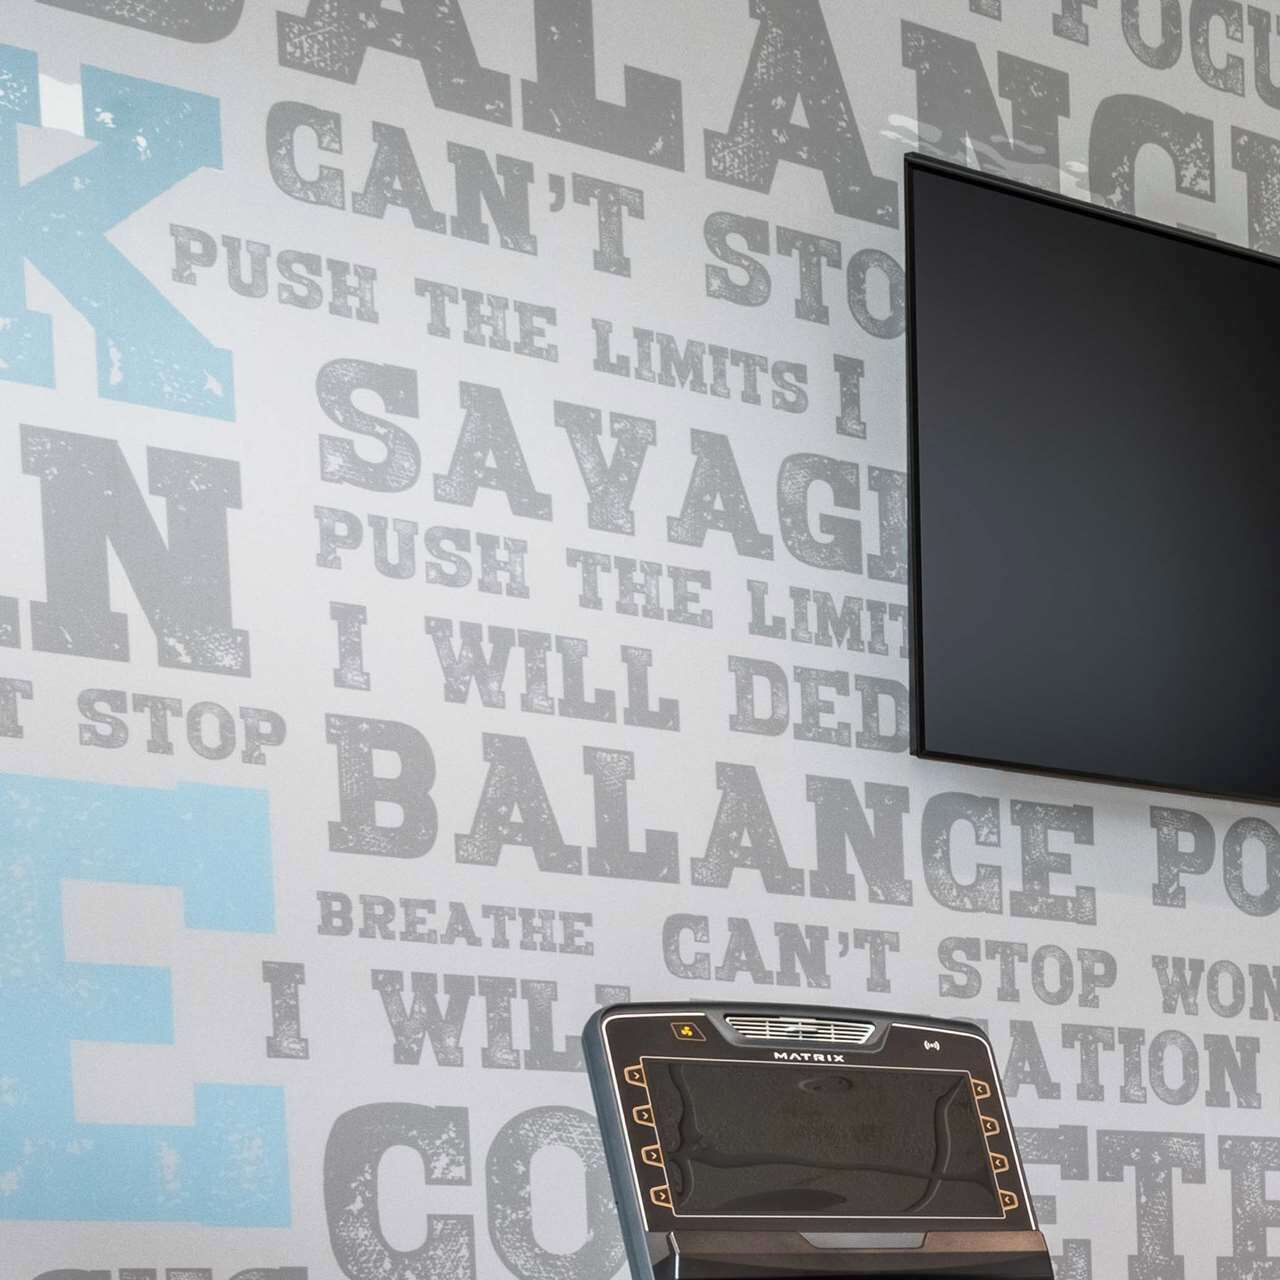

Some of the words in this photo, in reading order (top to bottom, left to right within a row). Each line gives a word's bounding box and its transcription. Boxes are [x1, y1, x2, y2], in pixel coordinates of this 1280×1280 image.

[266, 100, 644, 278] CAN'T
[169, 223, 379, 324] PUSH
[414, 277, 559, 362] THE
[591, 318, 809, 414] LIMITS
[832, 353, 867, 440] I
[314, 504, 530, 599] PUSH
[566, 547, 713, 628] THE
[77, 688, 287, 766] STOP
[329, 602, 370, 692] I
[424, 616, 681, 732] WILL
[324, 713, 1097, 926] BALANCE
[316, 890, 593, 956] BREATHE
[661, 912, 899, 992] CAN'T
[938, 937, 1117, 1009] STOP
[262, 961, 309, 1060] I
[371, 968, 632, 1073] WIL
[773, 1051, 845, 1063] MATRIX
